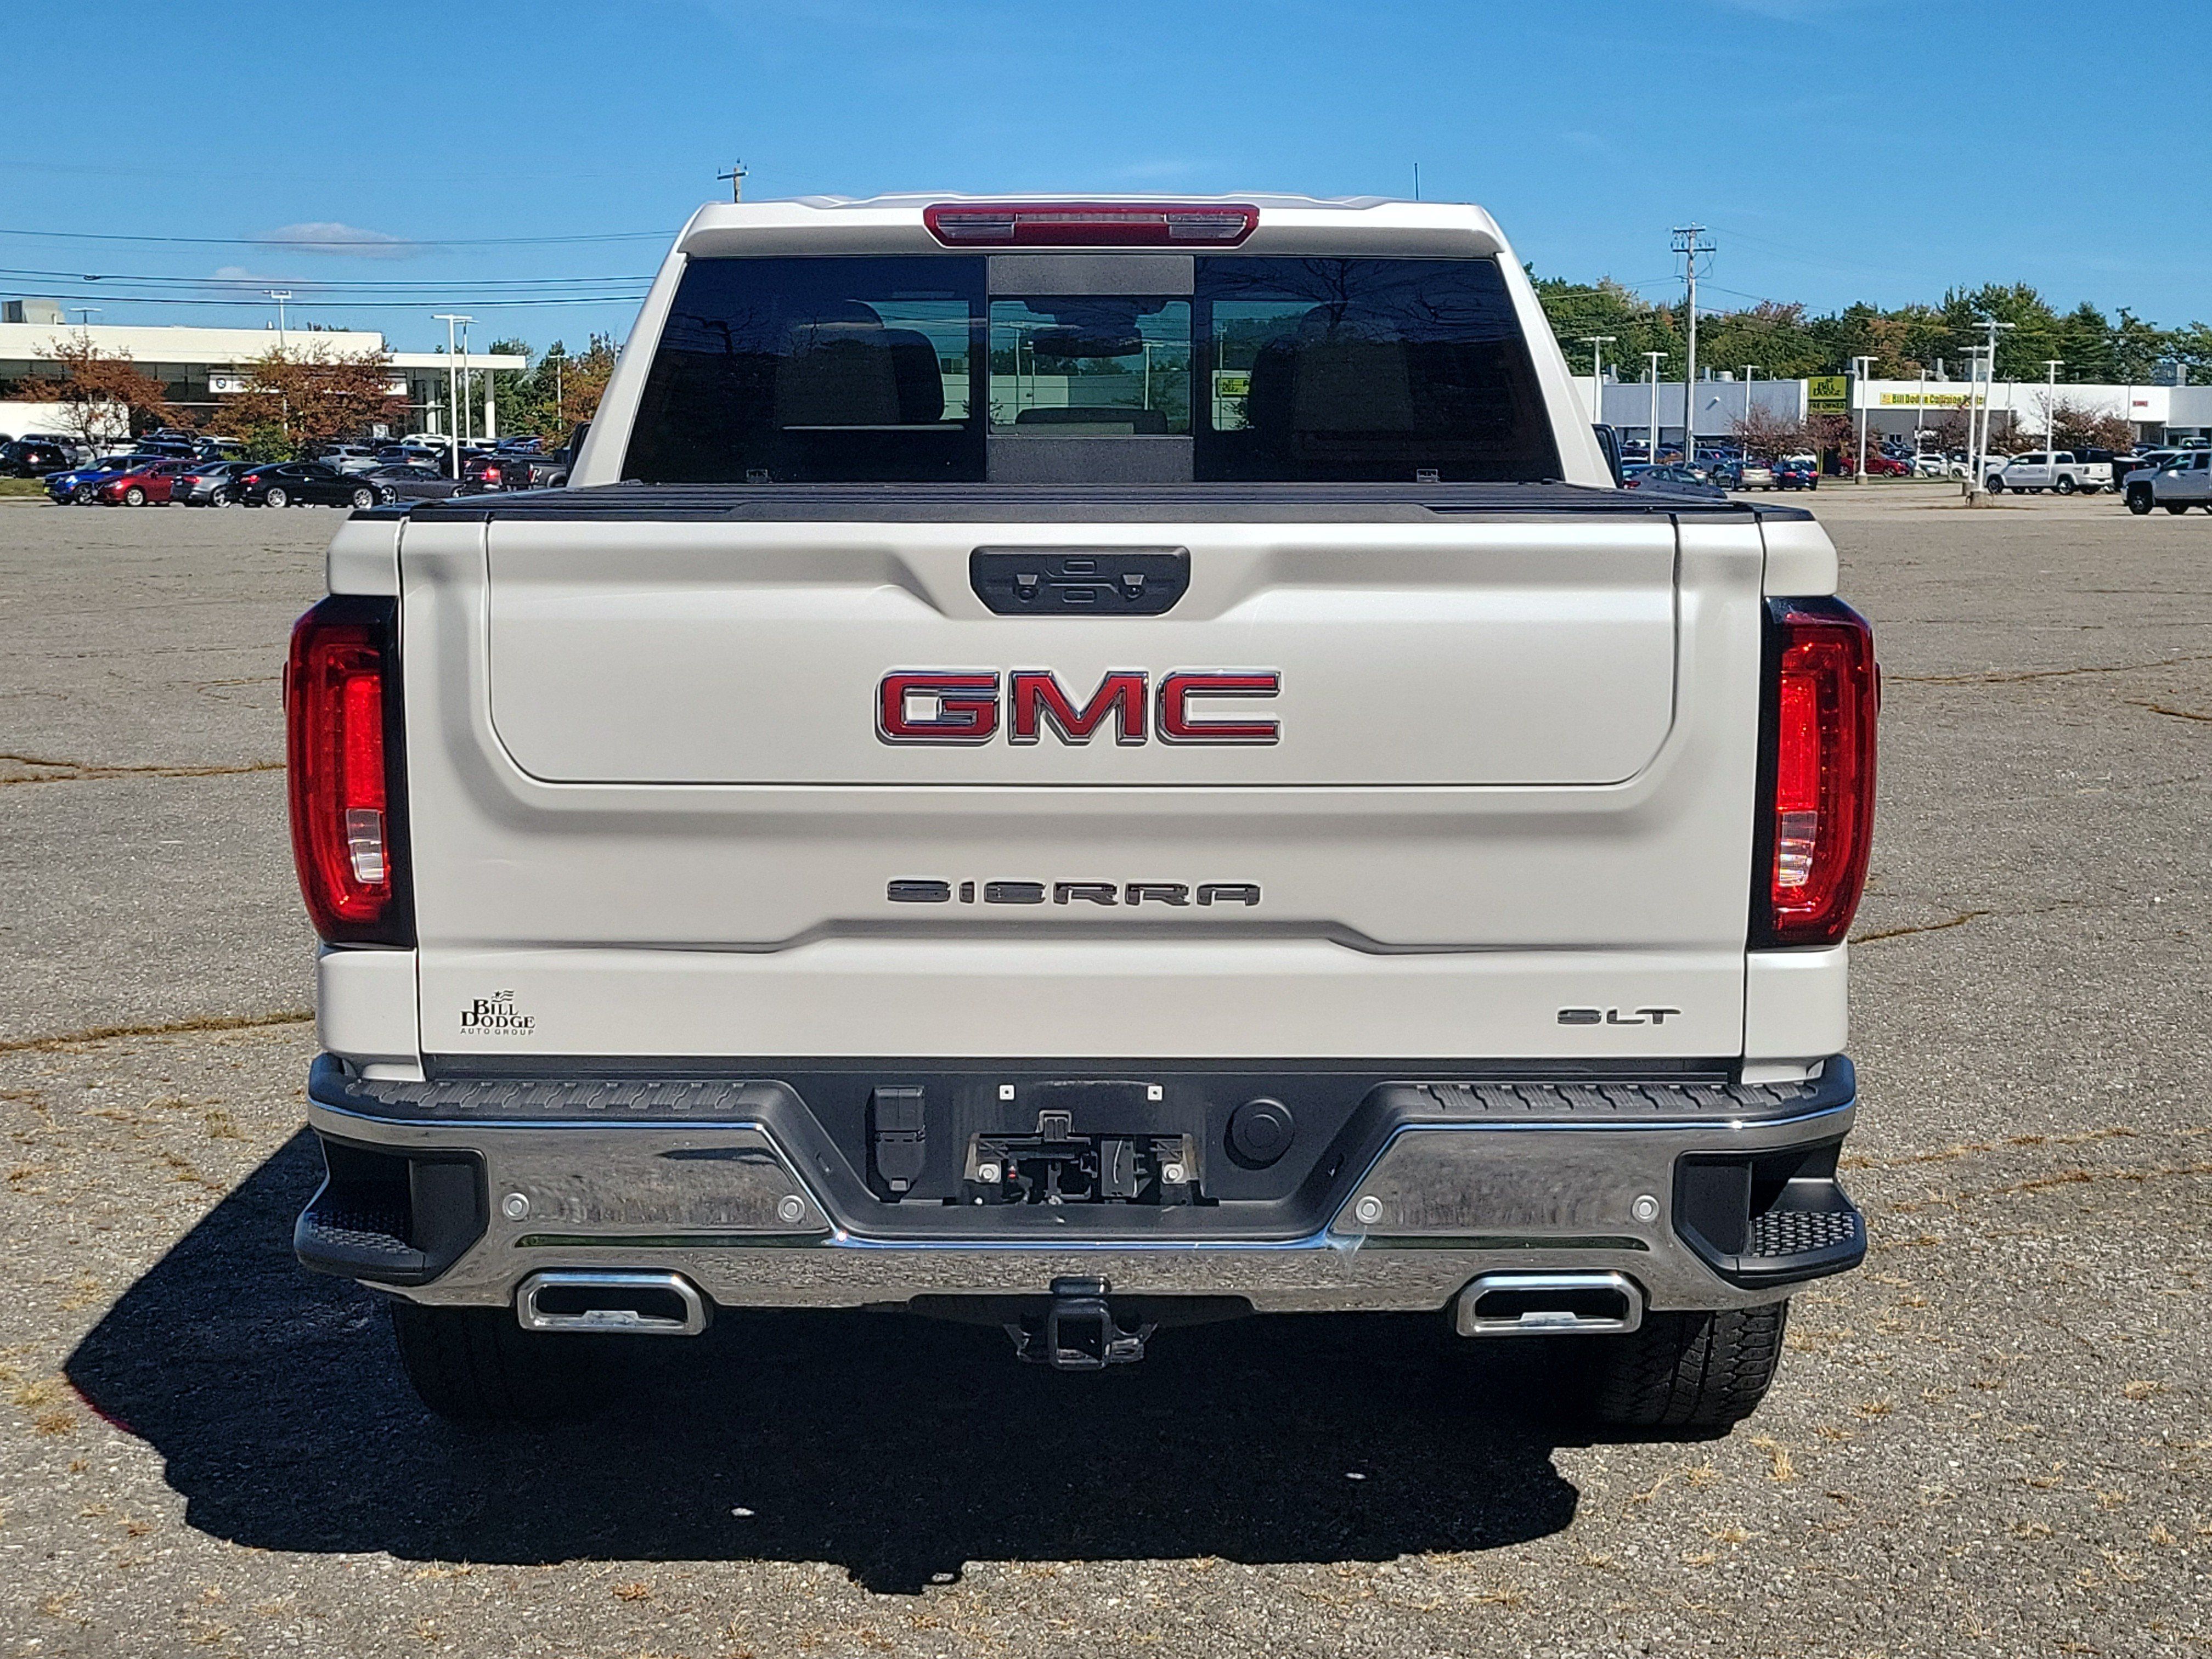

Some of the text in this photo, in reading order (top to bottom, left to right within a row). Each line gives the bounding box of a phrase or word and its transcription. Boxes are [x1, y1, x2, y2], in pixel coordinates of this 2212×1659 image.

[1905, 393, 1928, 404] Dode
[875, 668, 1281, 747] GMC
[887, 879, 1261, 906] SIERRA
[472, 998, 519, 1015] BILL
[460, 1011, 535, 1029] DODGE
[1558, 1008, 1681, 1025] SLT
